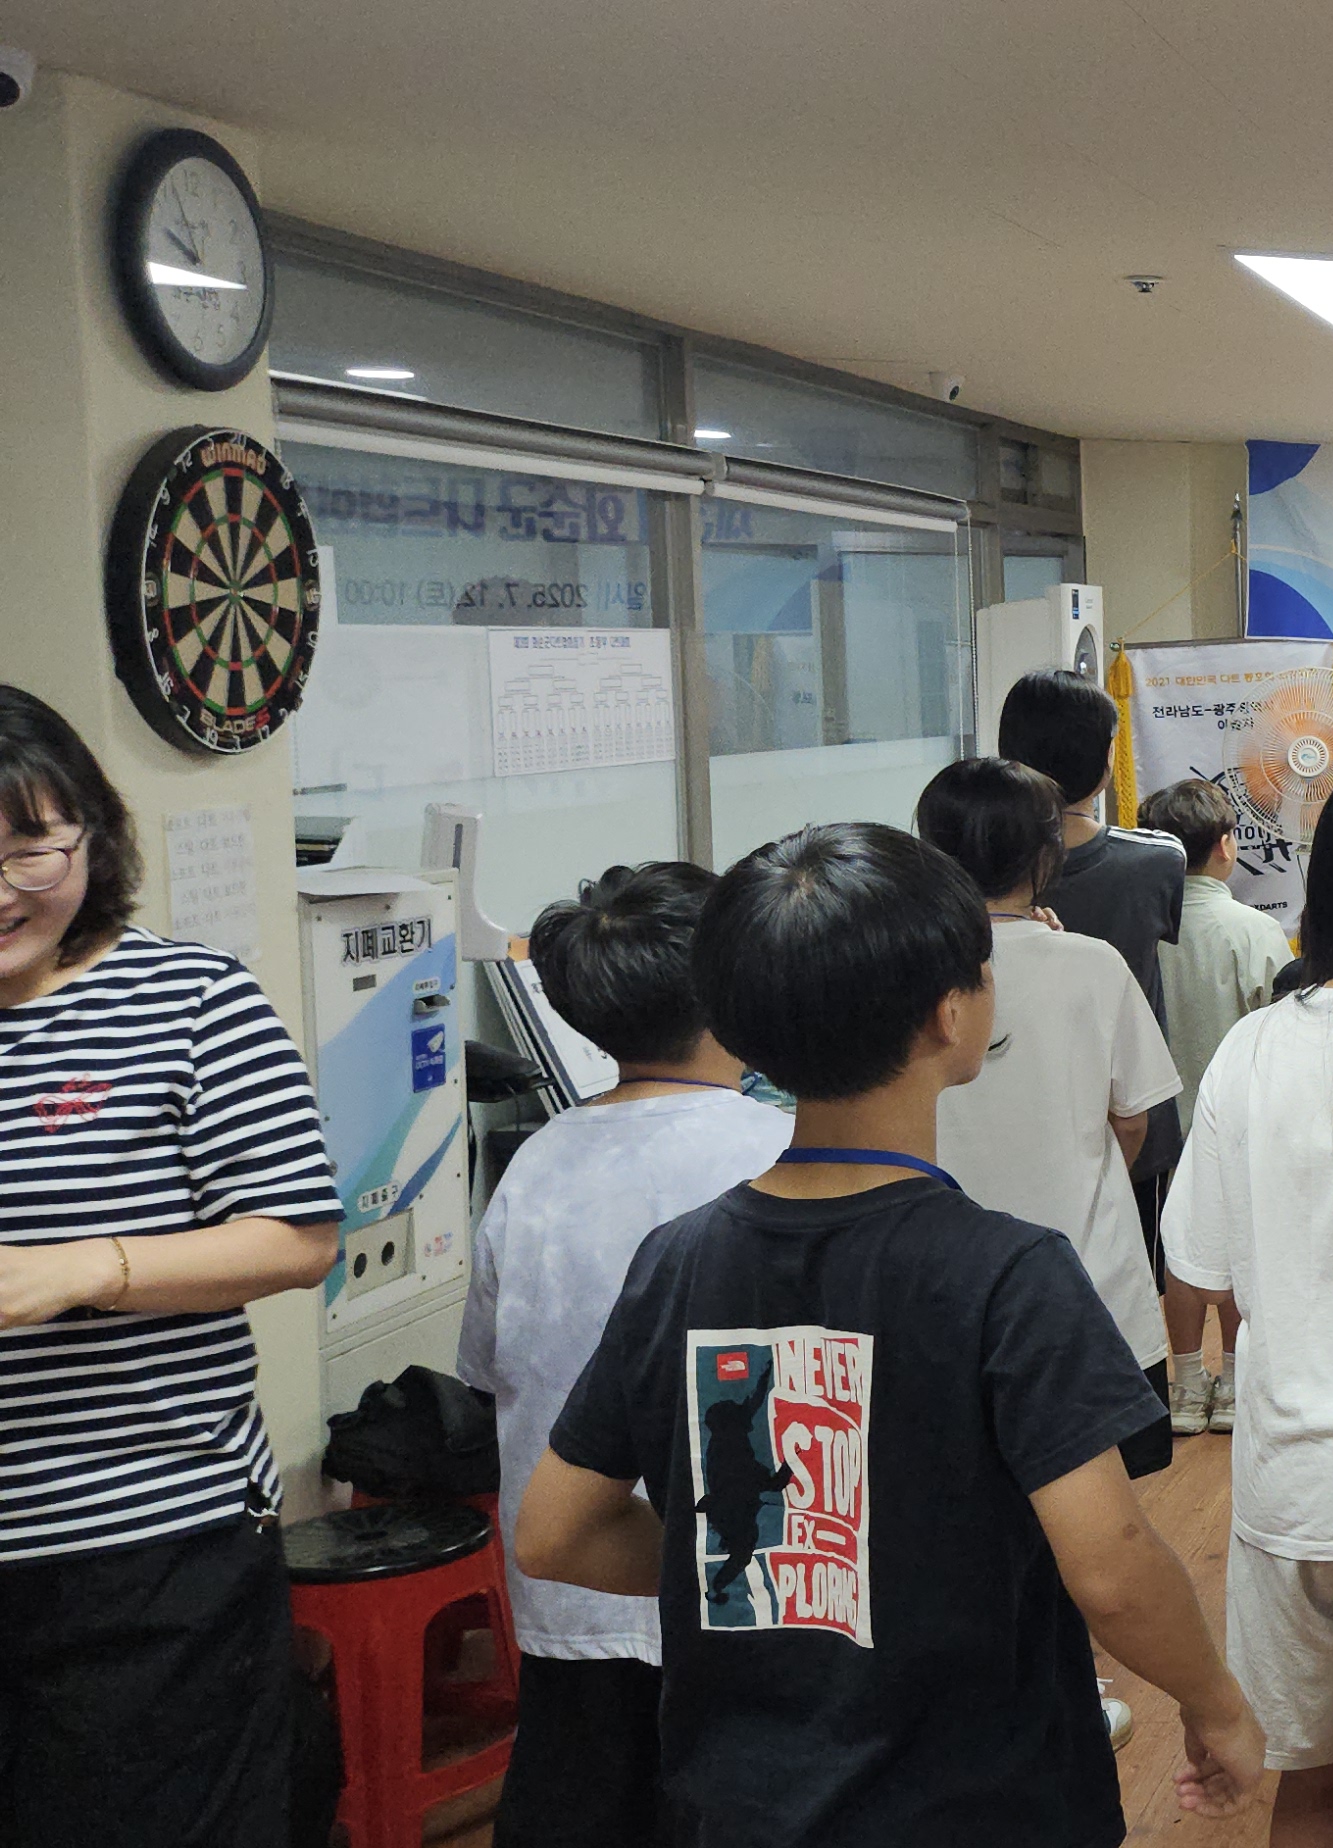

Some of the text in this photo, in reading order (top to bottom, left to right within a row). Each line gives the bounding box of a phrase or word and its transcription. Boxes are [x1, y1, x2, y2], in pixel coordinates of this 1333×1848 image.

[342, 917, 433, 965] 지폐교환기
[777, 1337, 863, 1403] NEVER
[781, 1421, 863, 1517] STOP
